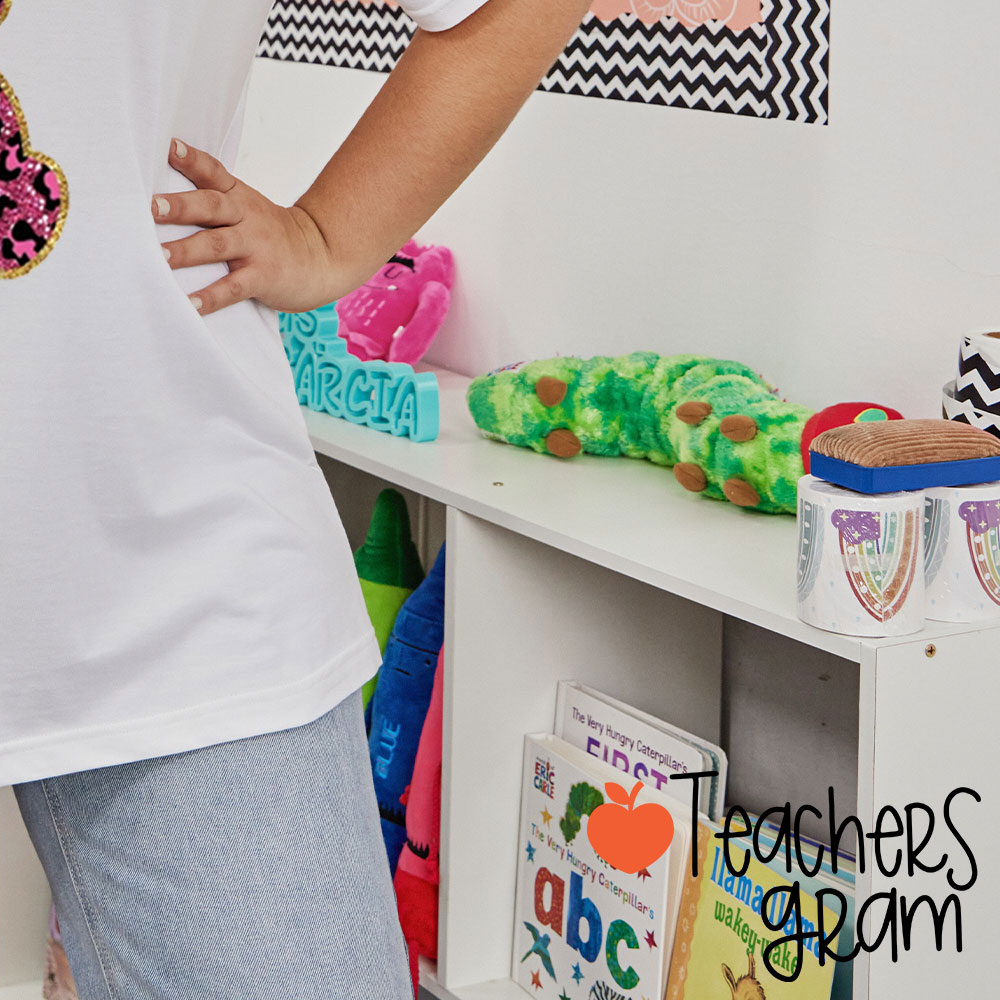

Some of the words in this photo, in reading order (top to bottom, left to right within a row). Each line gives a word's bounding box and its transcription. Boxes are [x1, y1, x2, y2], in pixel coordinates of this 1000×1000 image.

[374, 714, 402, 781] BLUE
[534, 761, 556, 786] ERIC
[572, 706, 586, 725] The
[586, 713, 605, 737] Very
[605, 724, 635, 752] Hungry
[636, 739, 688, 775] Caterpillar's
[533, 775, 555, 800] CARLE
[531, 822, 545, 843] The
[547, 834, 566, 861] Very
[566, 849, 597, 884] Hungry
[598, 872, 655, 920] Caterpillar's
[534, 866, 641, 990] abc
